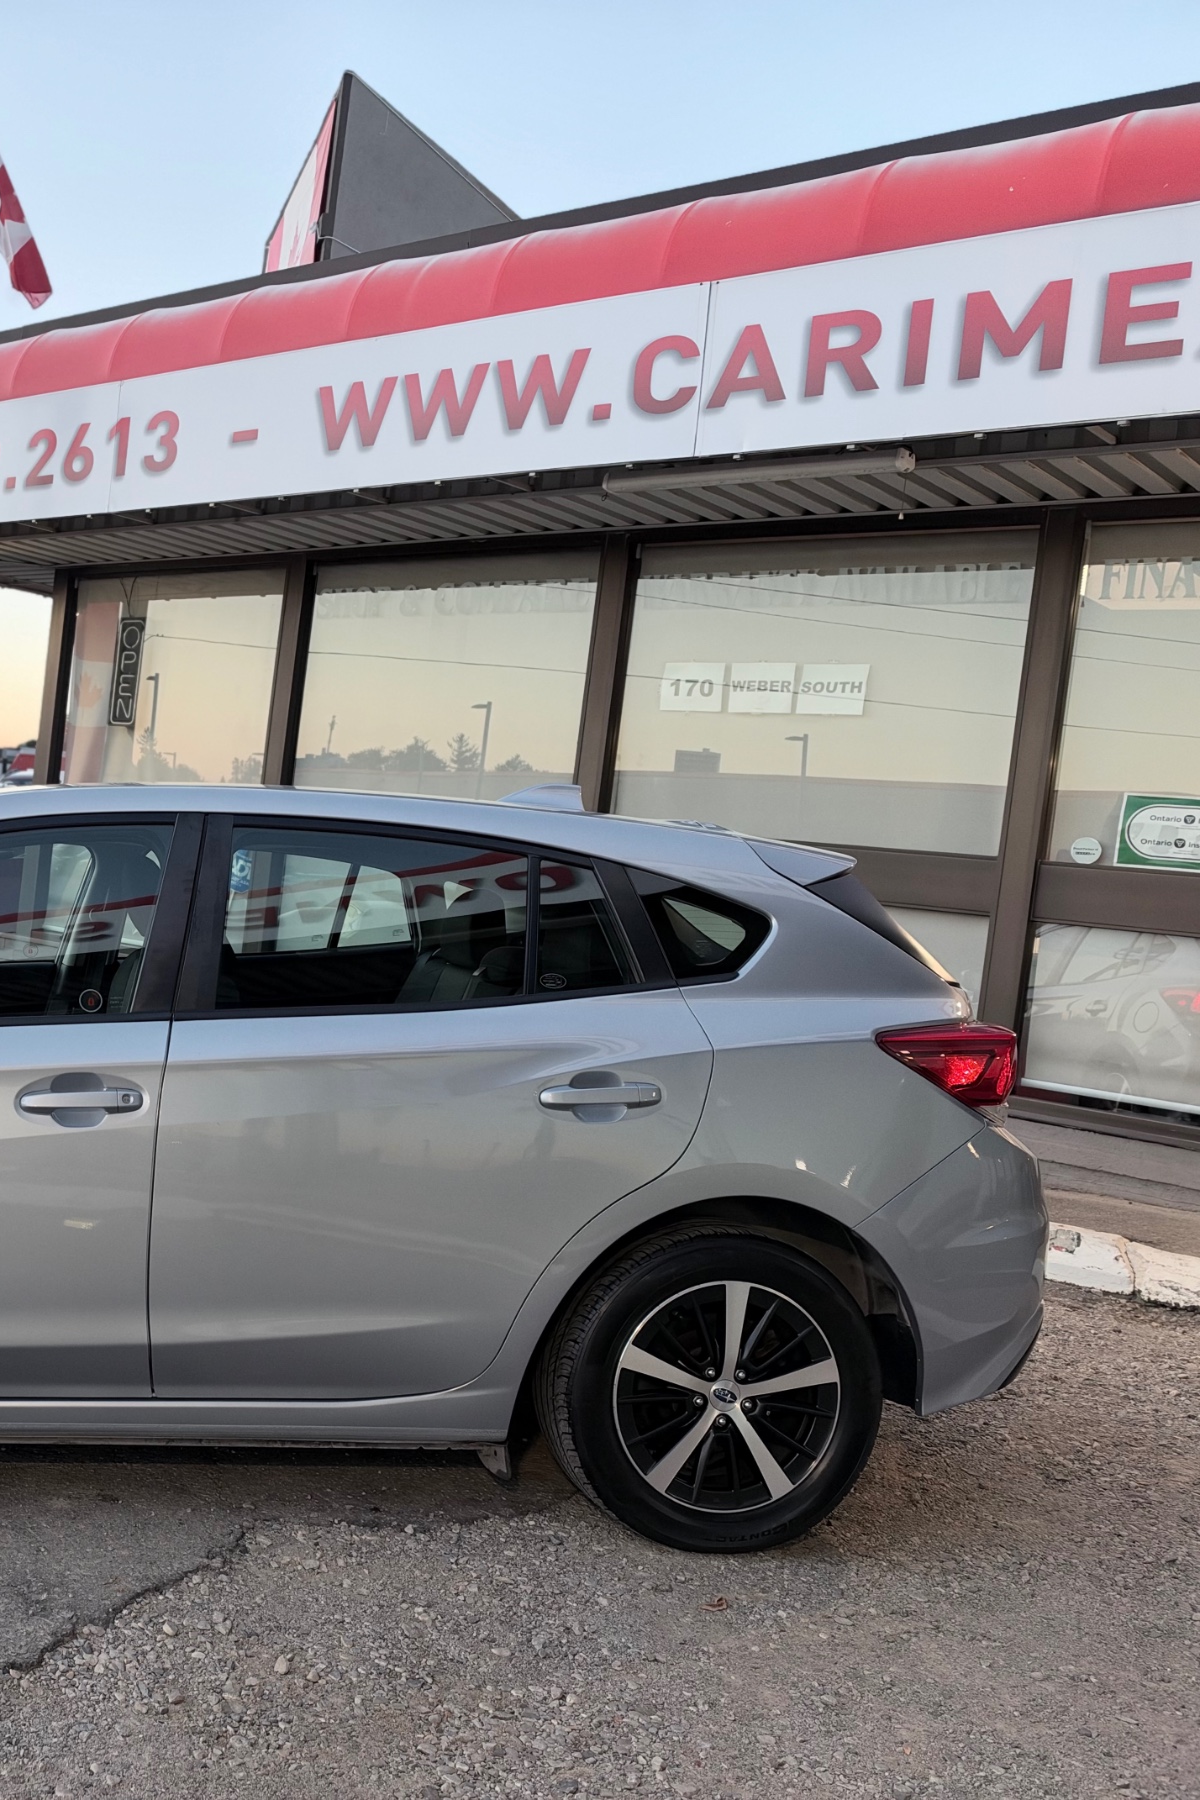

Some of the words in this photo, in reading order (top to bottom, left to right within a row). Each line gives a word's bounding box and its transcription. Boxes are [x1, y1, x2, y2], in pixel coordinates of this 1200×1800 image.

[1099, 556, 1200, 600] FINA
[116, 626, 140, 719] OPEN
[669, 678, 714, 697] 170
[731, 679, 792, 694] WEBER
[800, 680, 864, 694] SOUTH
[1149, 814, 1182, 823] Ontario
[1140, 838, 1173, 847] Ontario
